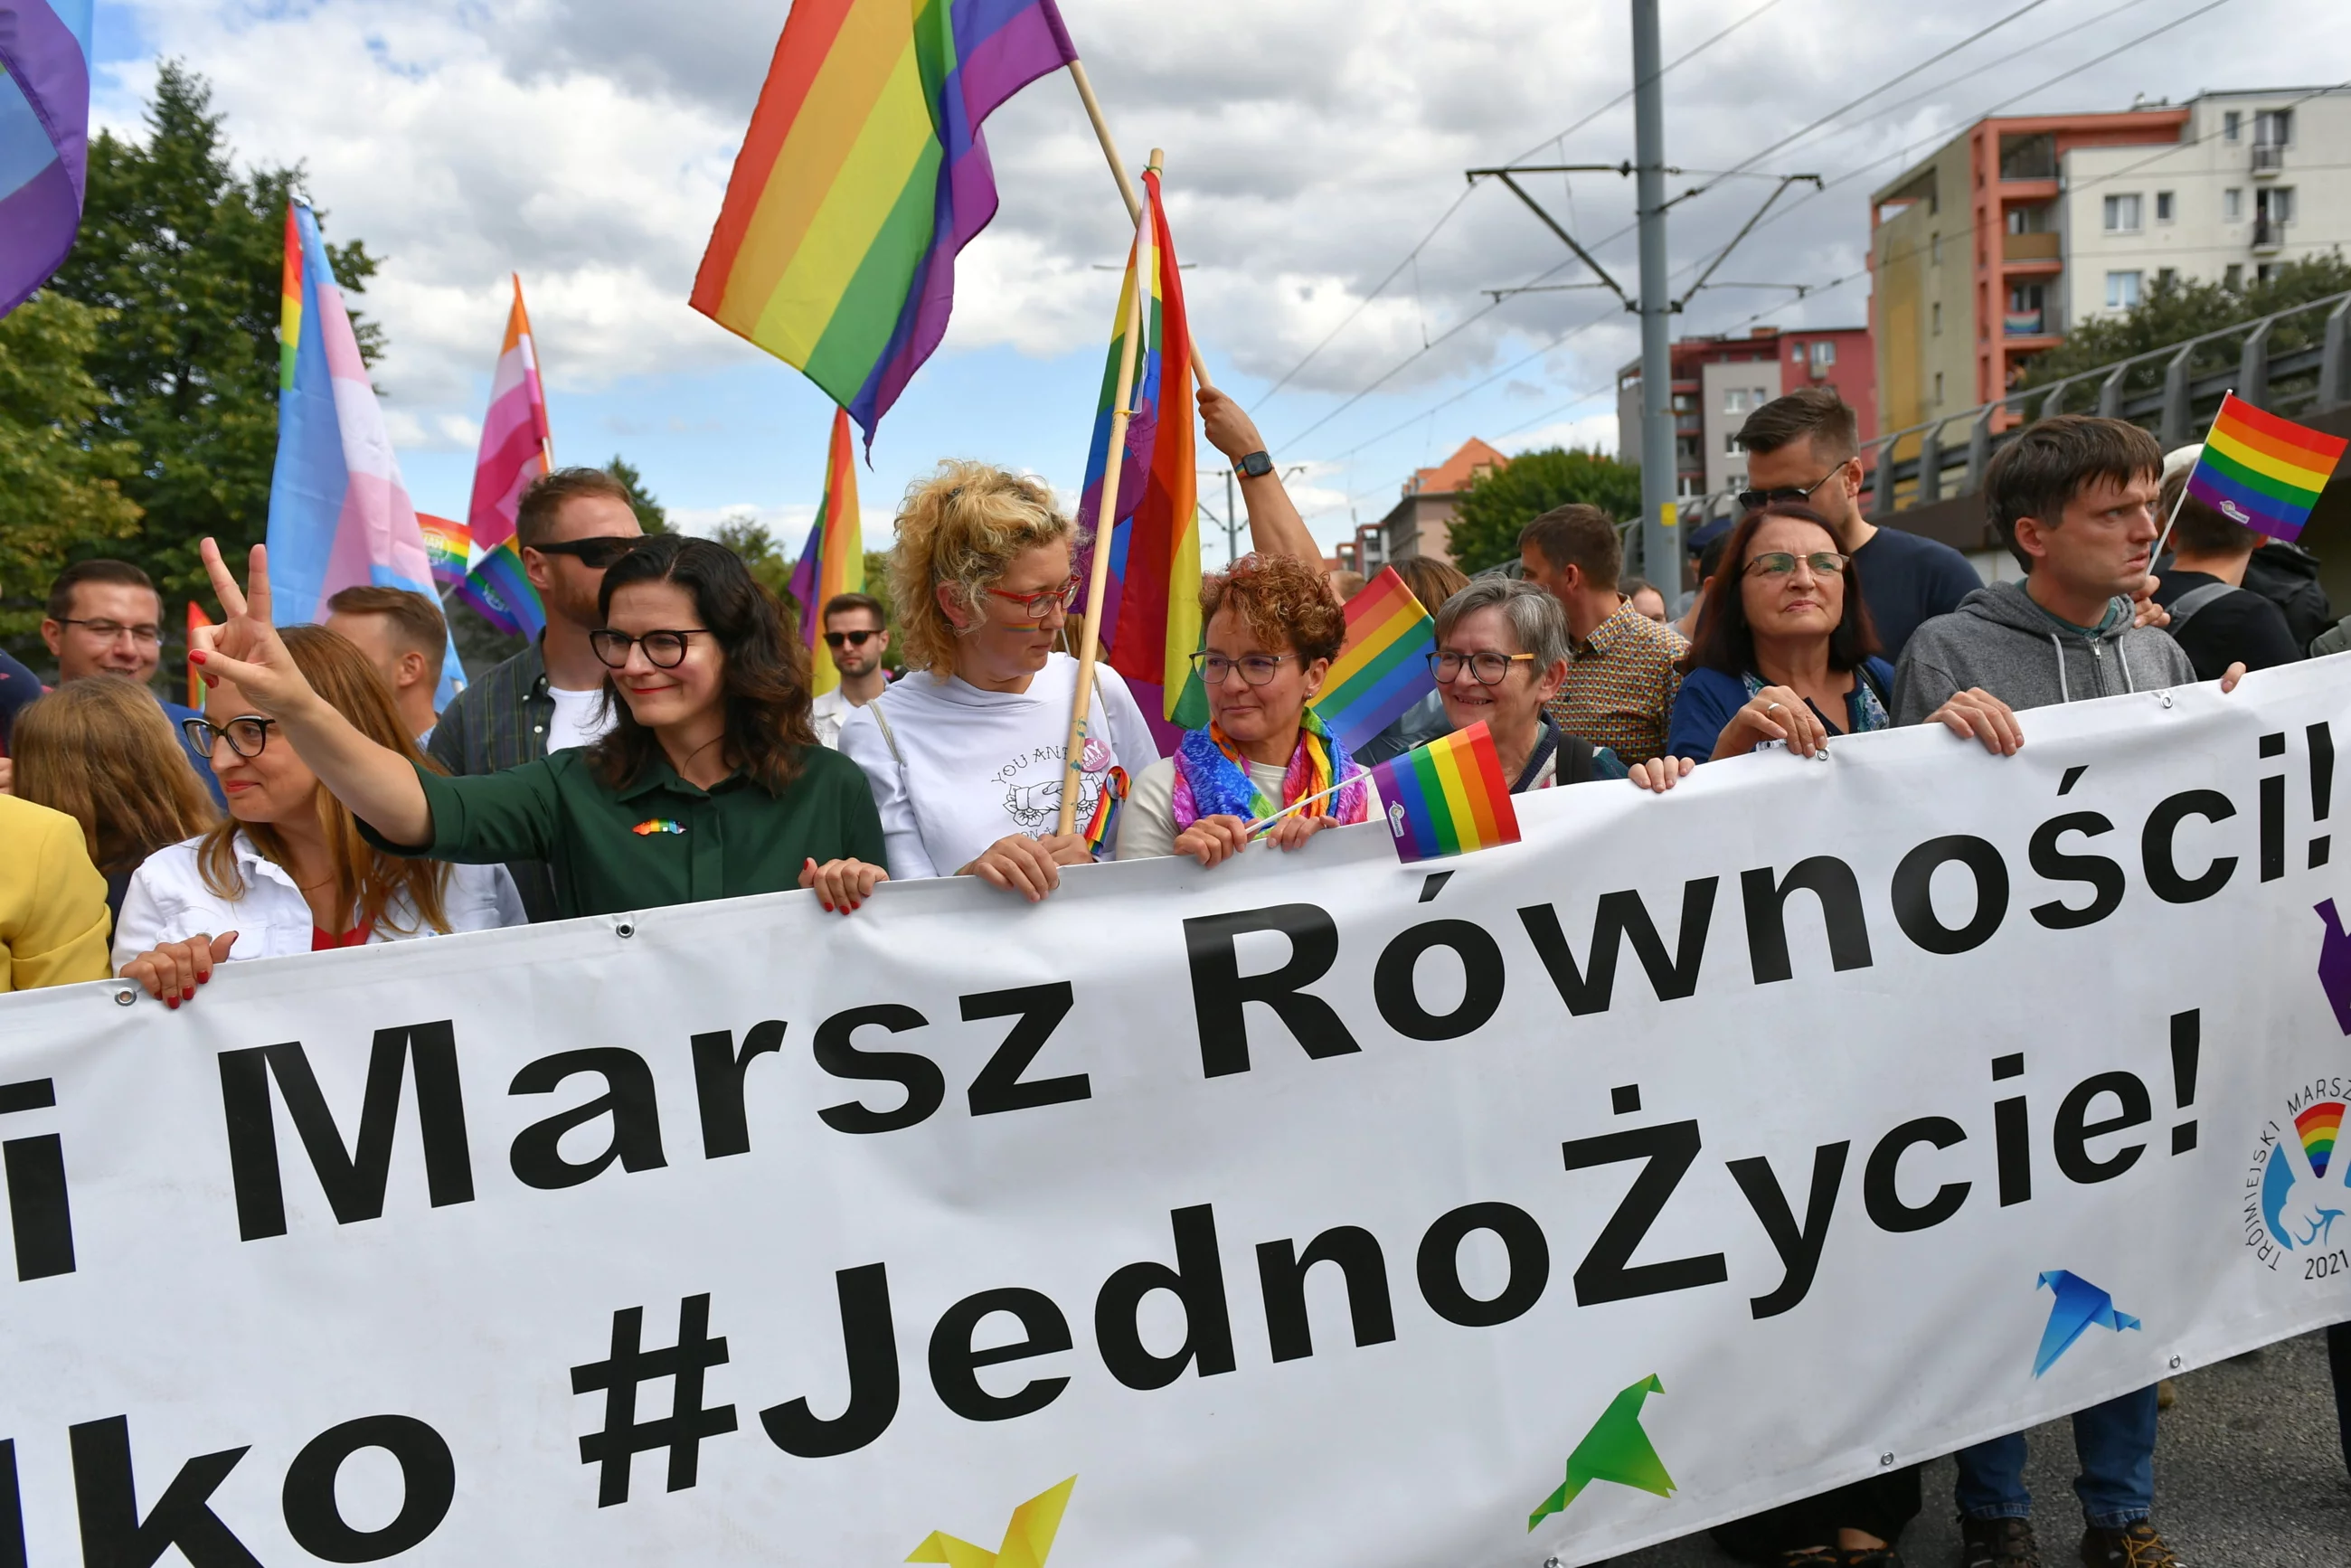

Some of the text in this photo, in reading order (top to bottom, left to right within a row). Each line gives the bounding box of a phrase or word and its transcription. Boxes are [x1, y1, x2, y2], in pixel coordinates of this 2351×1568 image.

[991, 754, 1028, 784] YOU
[218, 981, 1091, 1242] Marsz
[1183, 722, 2334, 1079] Równości!
[571, 1008, 2200, 1508] #JednoŻycie!
[2243, 1120, 2281, 1271] TRÓJMIEJSKI
[2304, 1250, 2349, 1280] 2021
